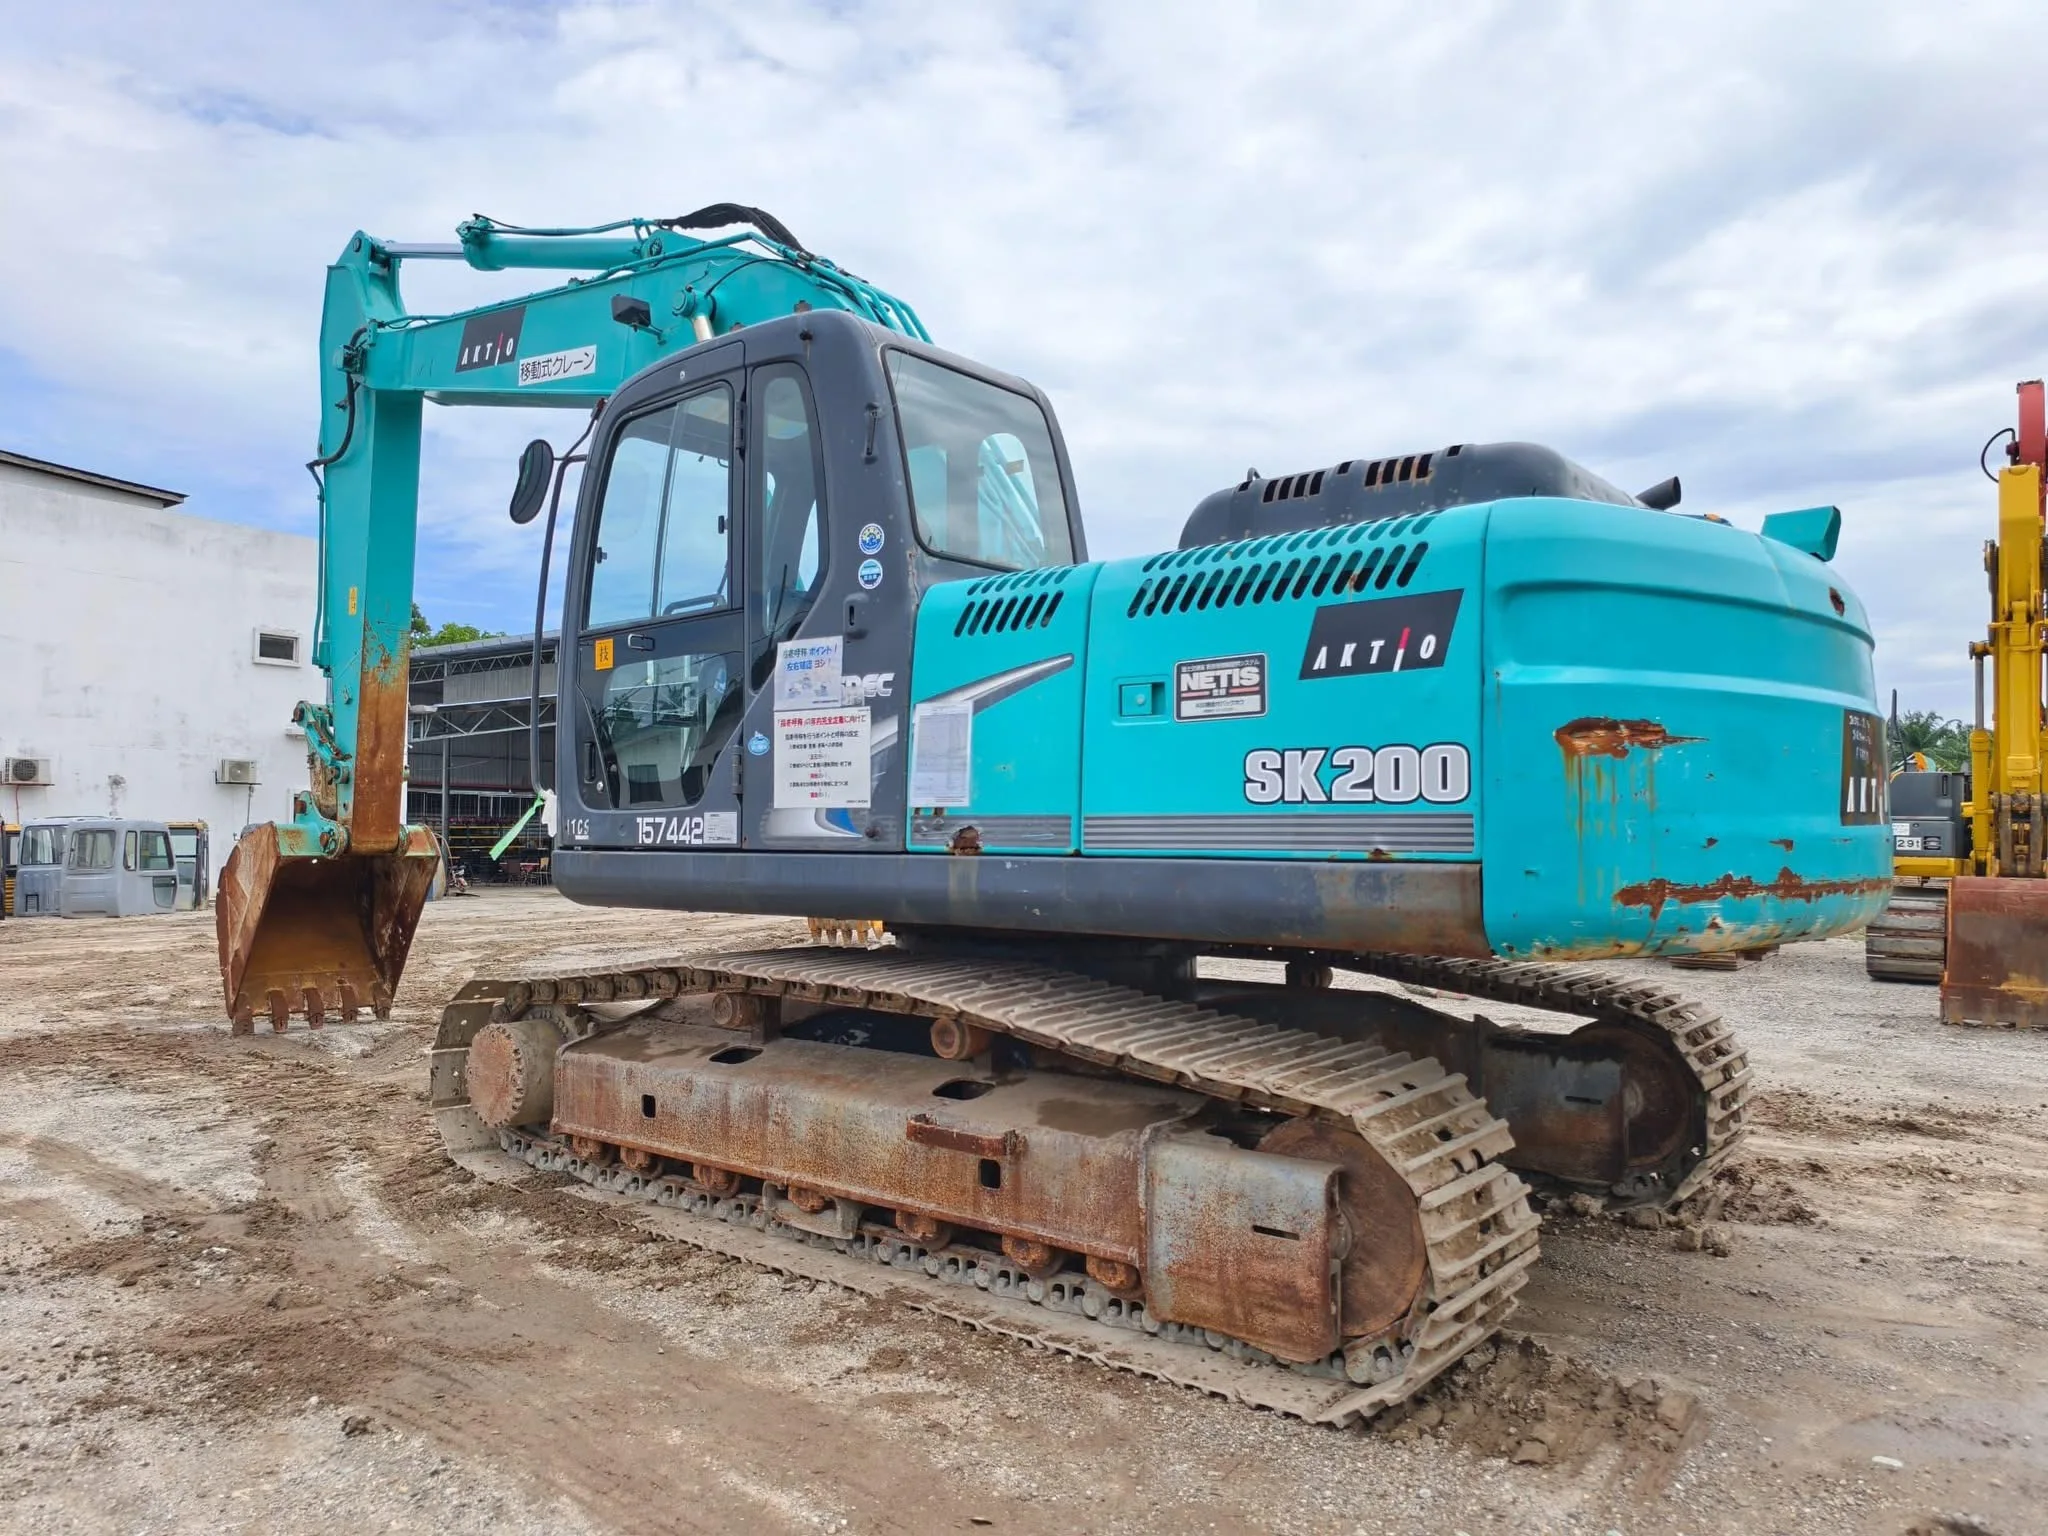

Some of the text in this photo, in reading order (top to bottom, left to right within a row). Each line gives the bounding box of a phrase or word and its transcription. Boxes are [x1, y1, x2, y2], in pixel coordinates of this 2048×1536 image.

[461, 331, 514, 366] AKTIO
[520, 351, 595, 382] 移動式クレーン
[1312, 627, 1437, 672] AKTIO
[1180, 666, 1260, 692] NETIS
[1244, 742, 1471, 805] SK200
[636, 817, 704, 845] 157442
